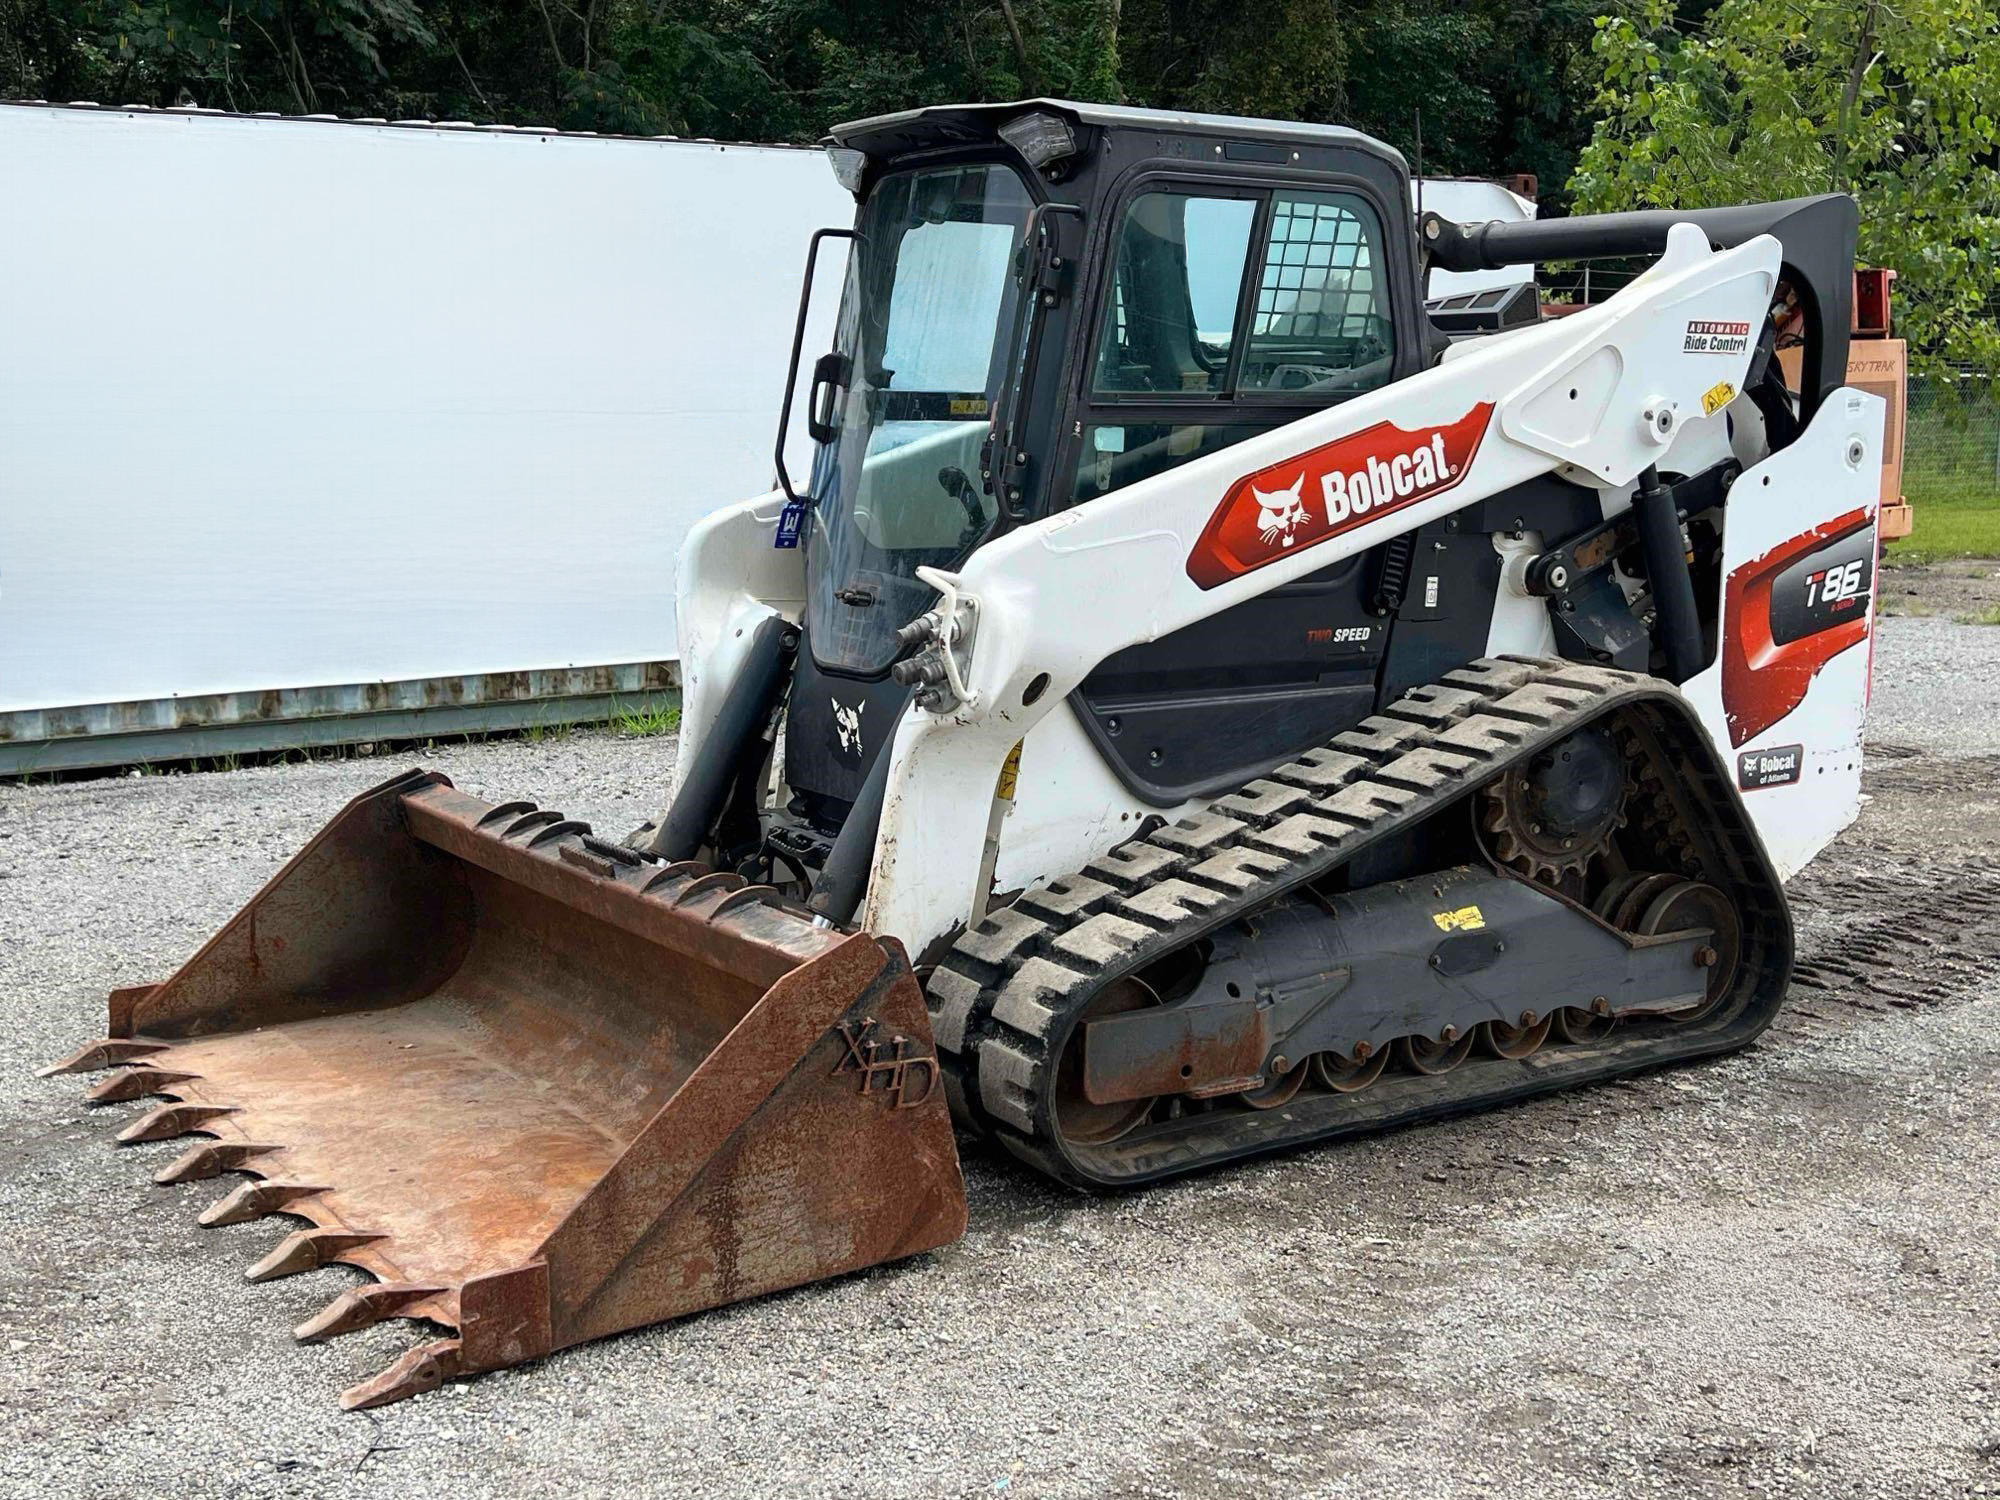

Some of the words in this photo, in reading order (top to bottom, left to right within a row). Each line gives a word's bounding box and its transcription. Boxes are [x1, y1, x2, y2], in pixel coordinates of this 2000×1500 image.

[1688, 323, 1748, 335] AUTOMATIC
[1684, 335, 1707, 350] Ride
[1321, 432, 1450, 525] Bobcat
[1806, 559, 1863, 608] T86
[1307, 629, 1332, 642] TWO
[1333, 627, 1371, 642] SPEED
[1760, 753, 1795, 774] Bobcat
[1760, 775, 1767, 784] of
[830, 1016, 940, 1109] XHD
